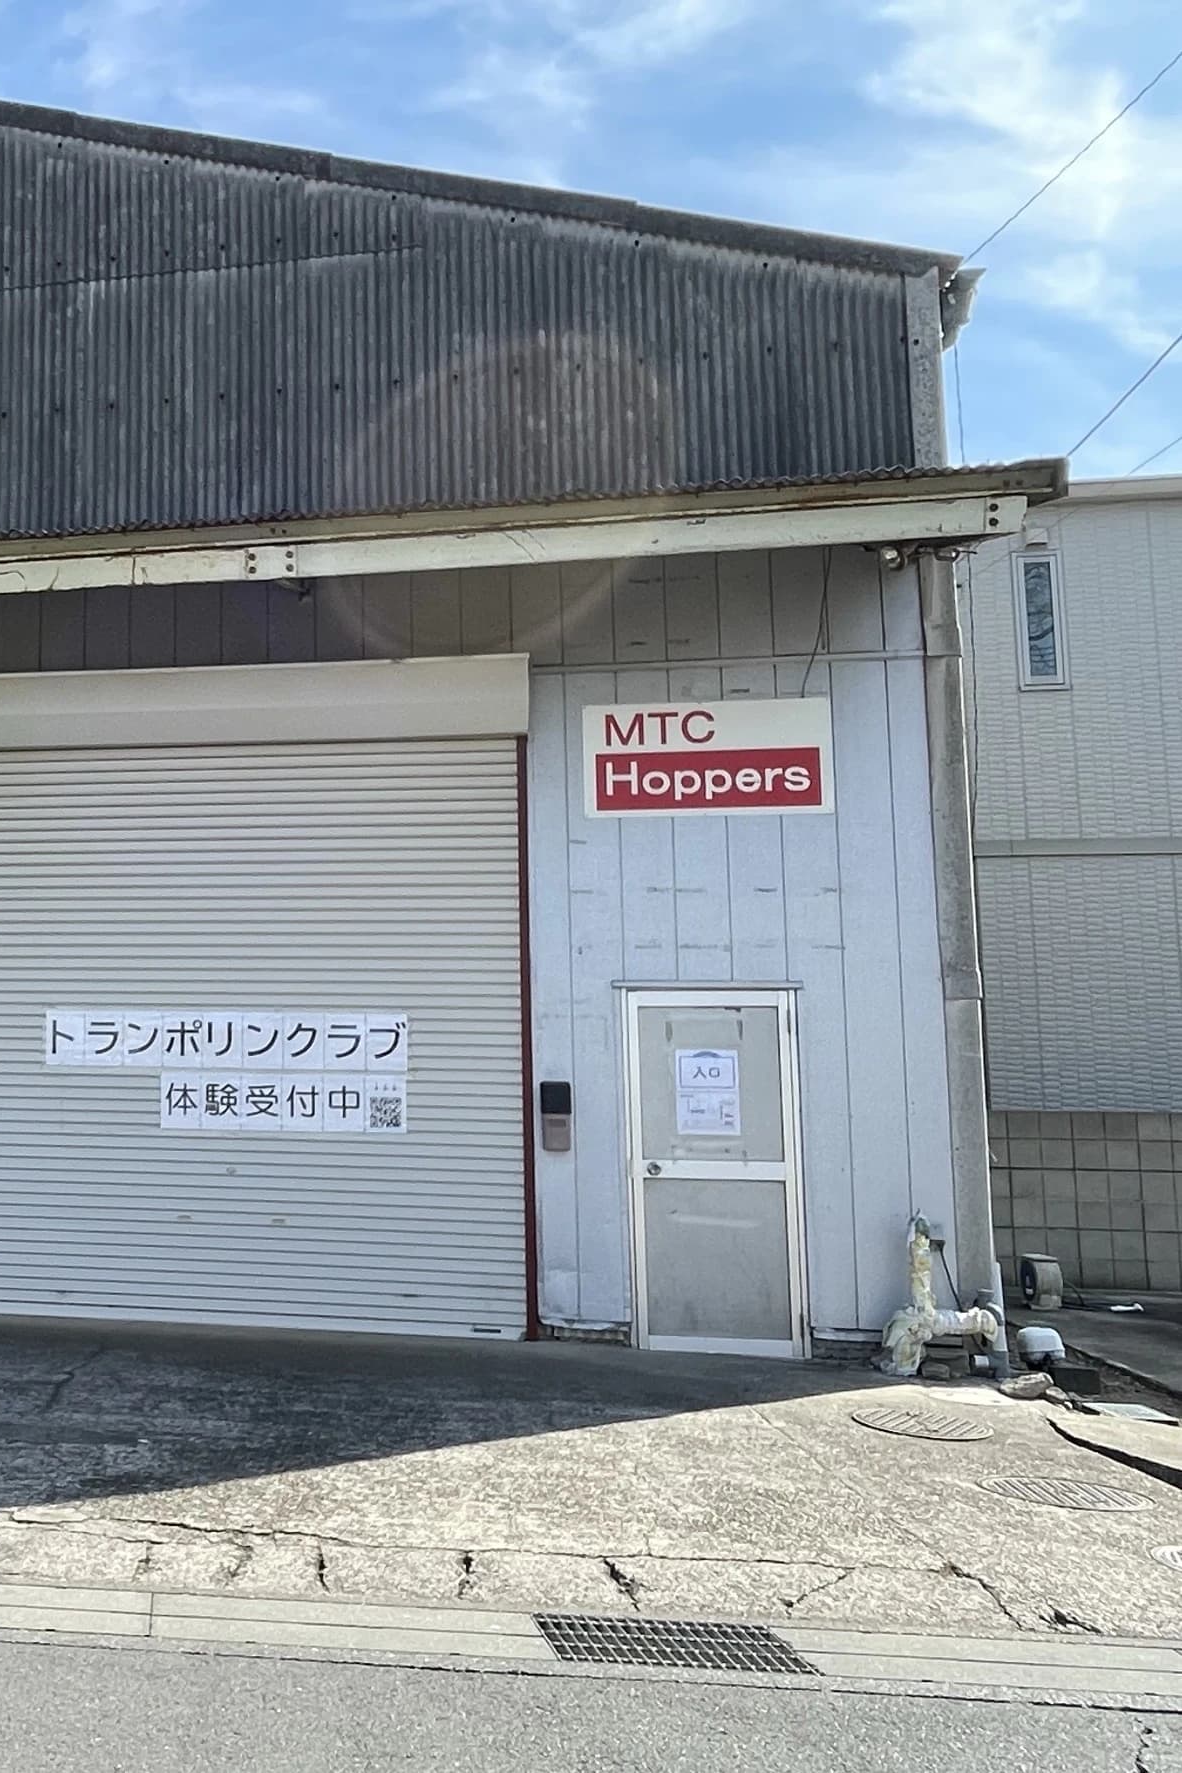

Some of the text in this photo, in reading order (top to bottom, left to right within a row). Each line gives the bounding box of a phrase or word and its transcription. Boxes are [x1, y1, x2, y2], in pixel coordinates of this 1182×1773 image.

[604, 710, 715, 746] MTC
[605, 760, 812, 801] Hoppers
[51, 1018, 407, 1060] トランポリンクラブ
[692, 1066, 721, 1079] 入口
[165, 1082, 361, 1119] 体験受付中
